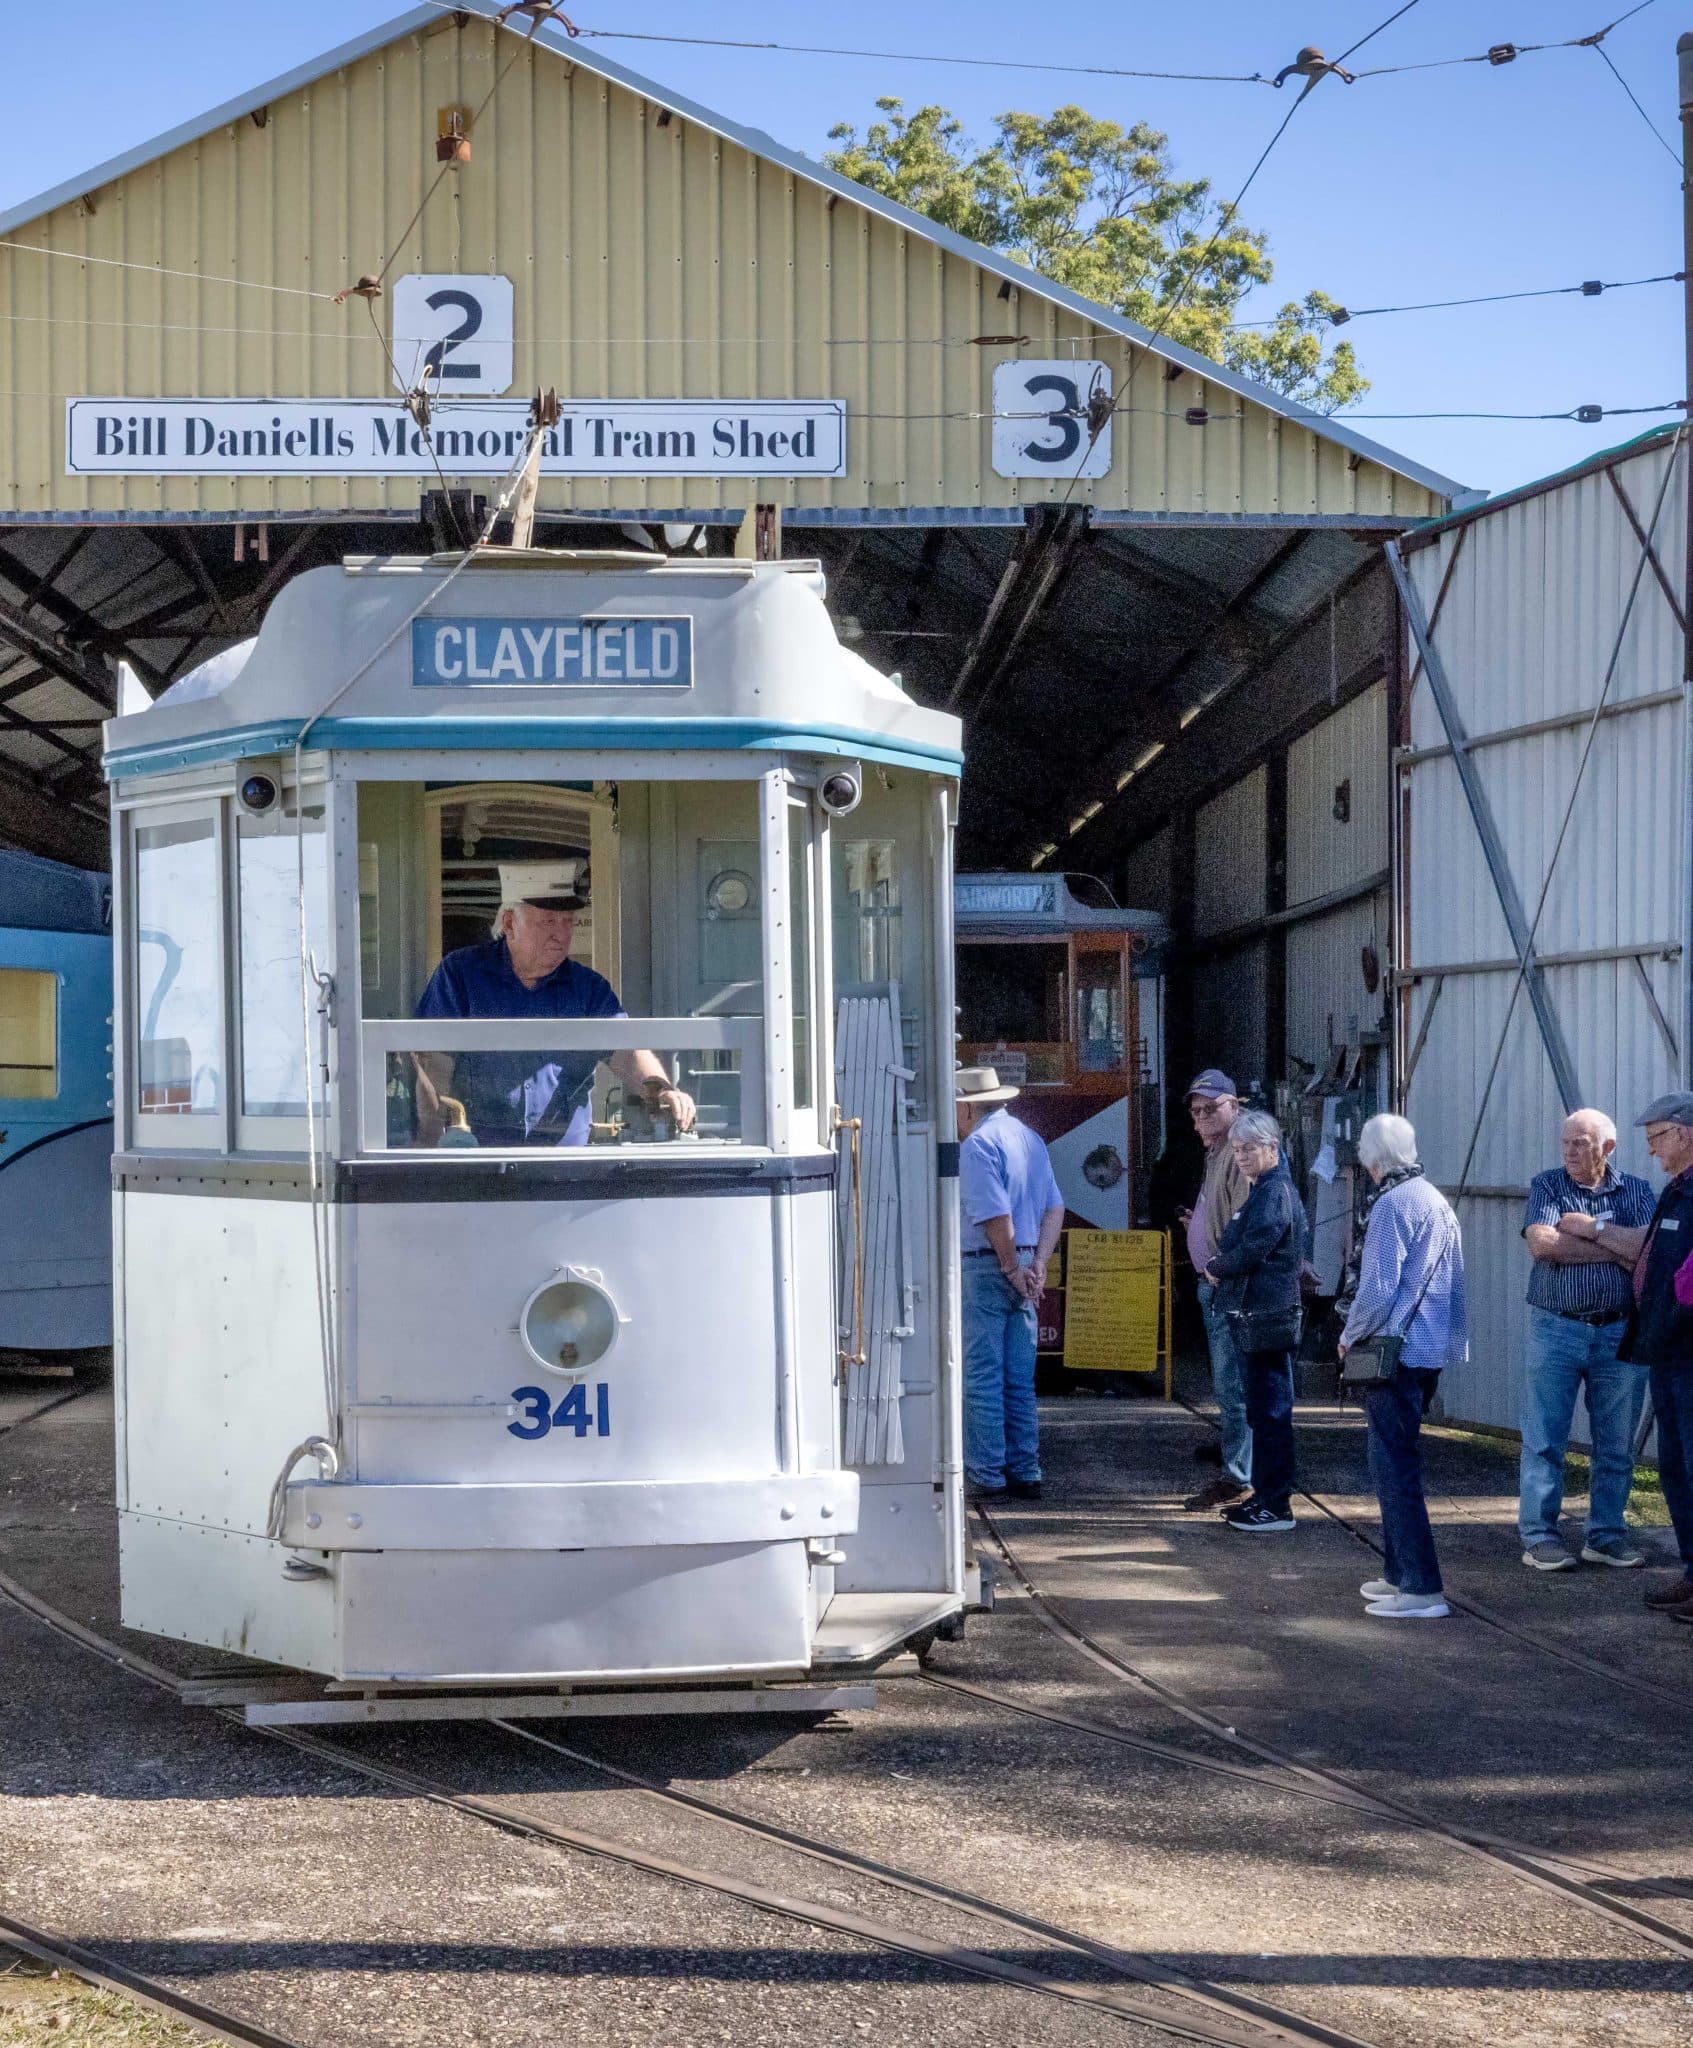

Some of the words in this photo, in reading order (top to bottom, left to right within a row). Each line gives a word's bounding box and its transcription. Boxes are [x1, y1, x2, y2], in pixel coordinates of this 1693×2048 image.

[424, 290, 482, 378] 2
[95, 416, 167, 456] Bill
[184, 416, 354, 457] Daniells
[371, 417, 573, 457] Memorial
[586, 418, 696, 457] Tram
[713, 417, 816, 458] Shed
[1024, 374, 1081, 462] 3
[434, 626, 679, 679] CLAYFIELD
[507, 1383, 610, 1440] 341
